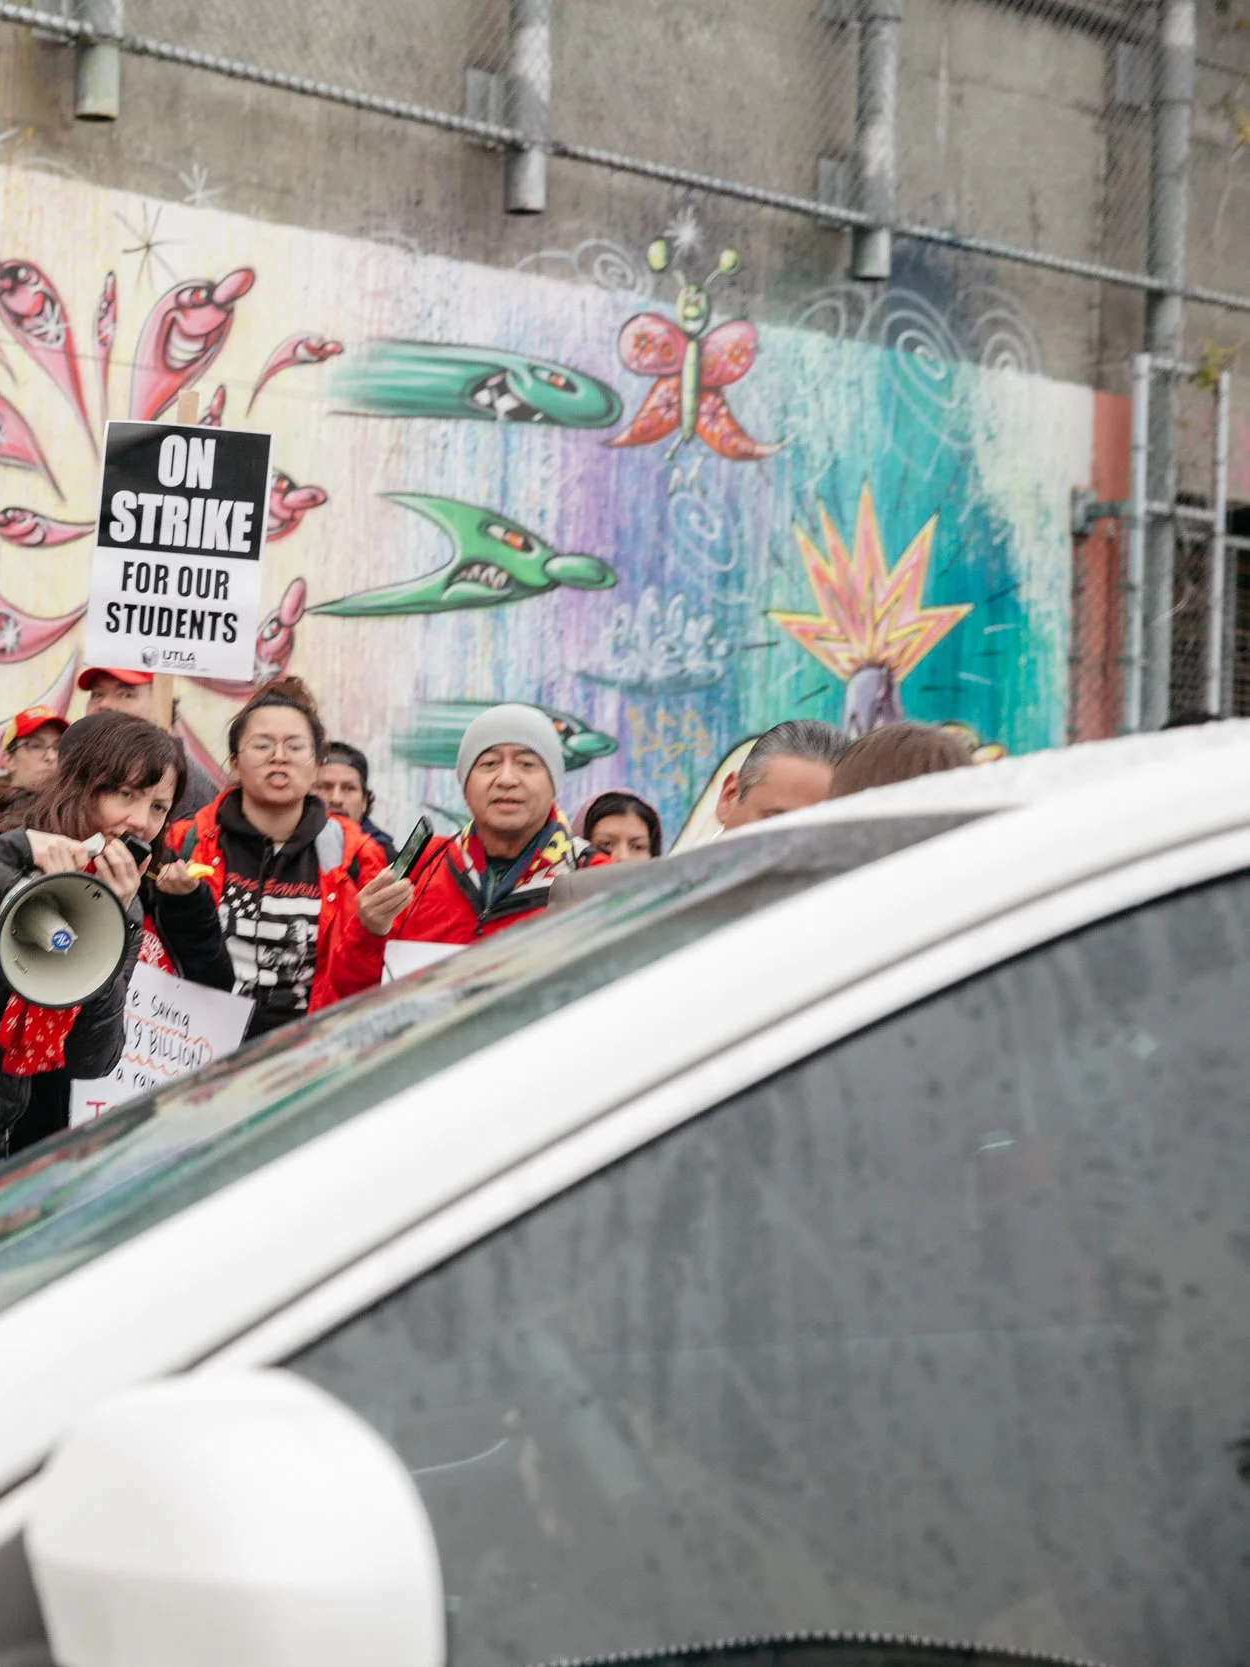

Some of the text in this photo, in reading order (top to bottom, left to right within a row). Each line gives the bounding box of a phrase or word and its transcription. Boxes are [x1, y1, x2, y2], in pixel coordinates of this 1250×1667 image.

[157, 434, 217, 490] ON
[108, 489, 255, 553] STRIKE
[121, 560, 230, 601] FOR OUR
[105, 601, 238, 644] STUDENTS
[162, 650, 196, 662] UTLA
[149, 1028, 204, 1069] BILLION
[116, 1068, 125, 1083] a
